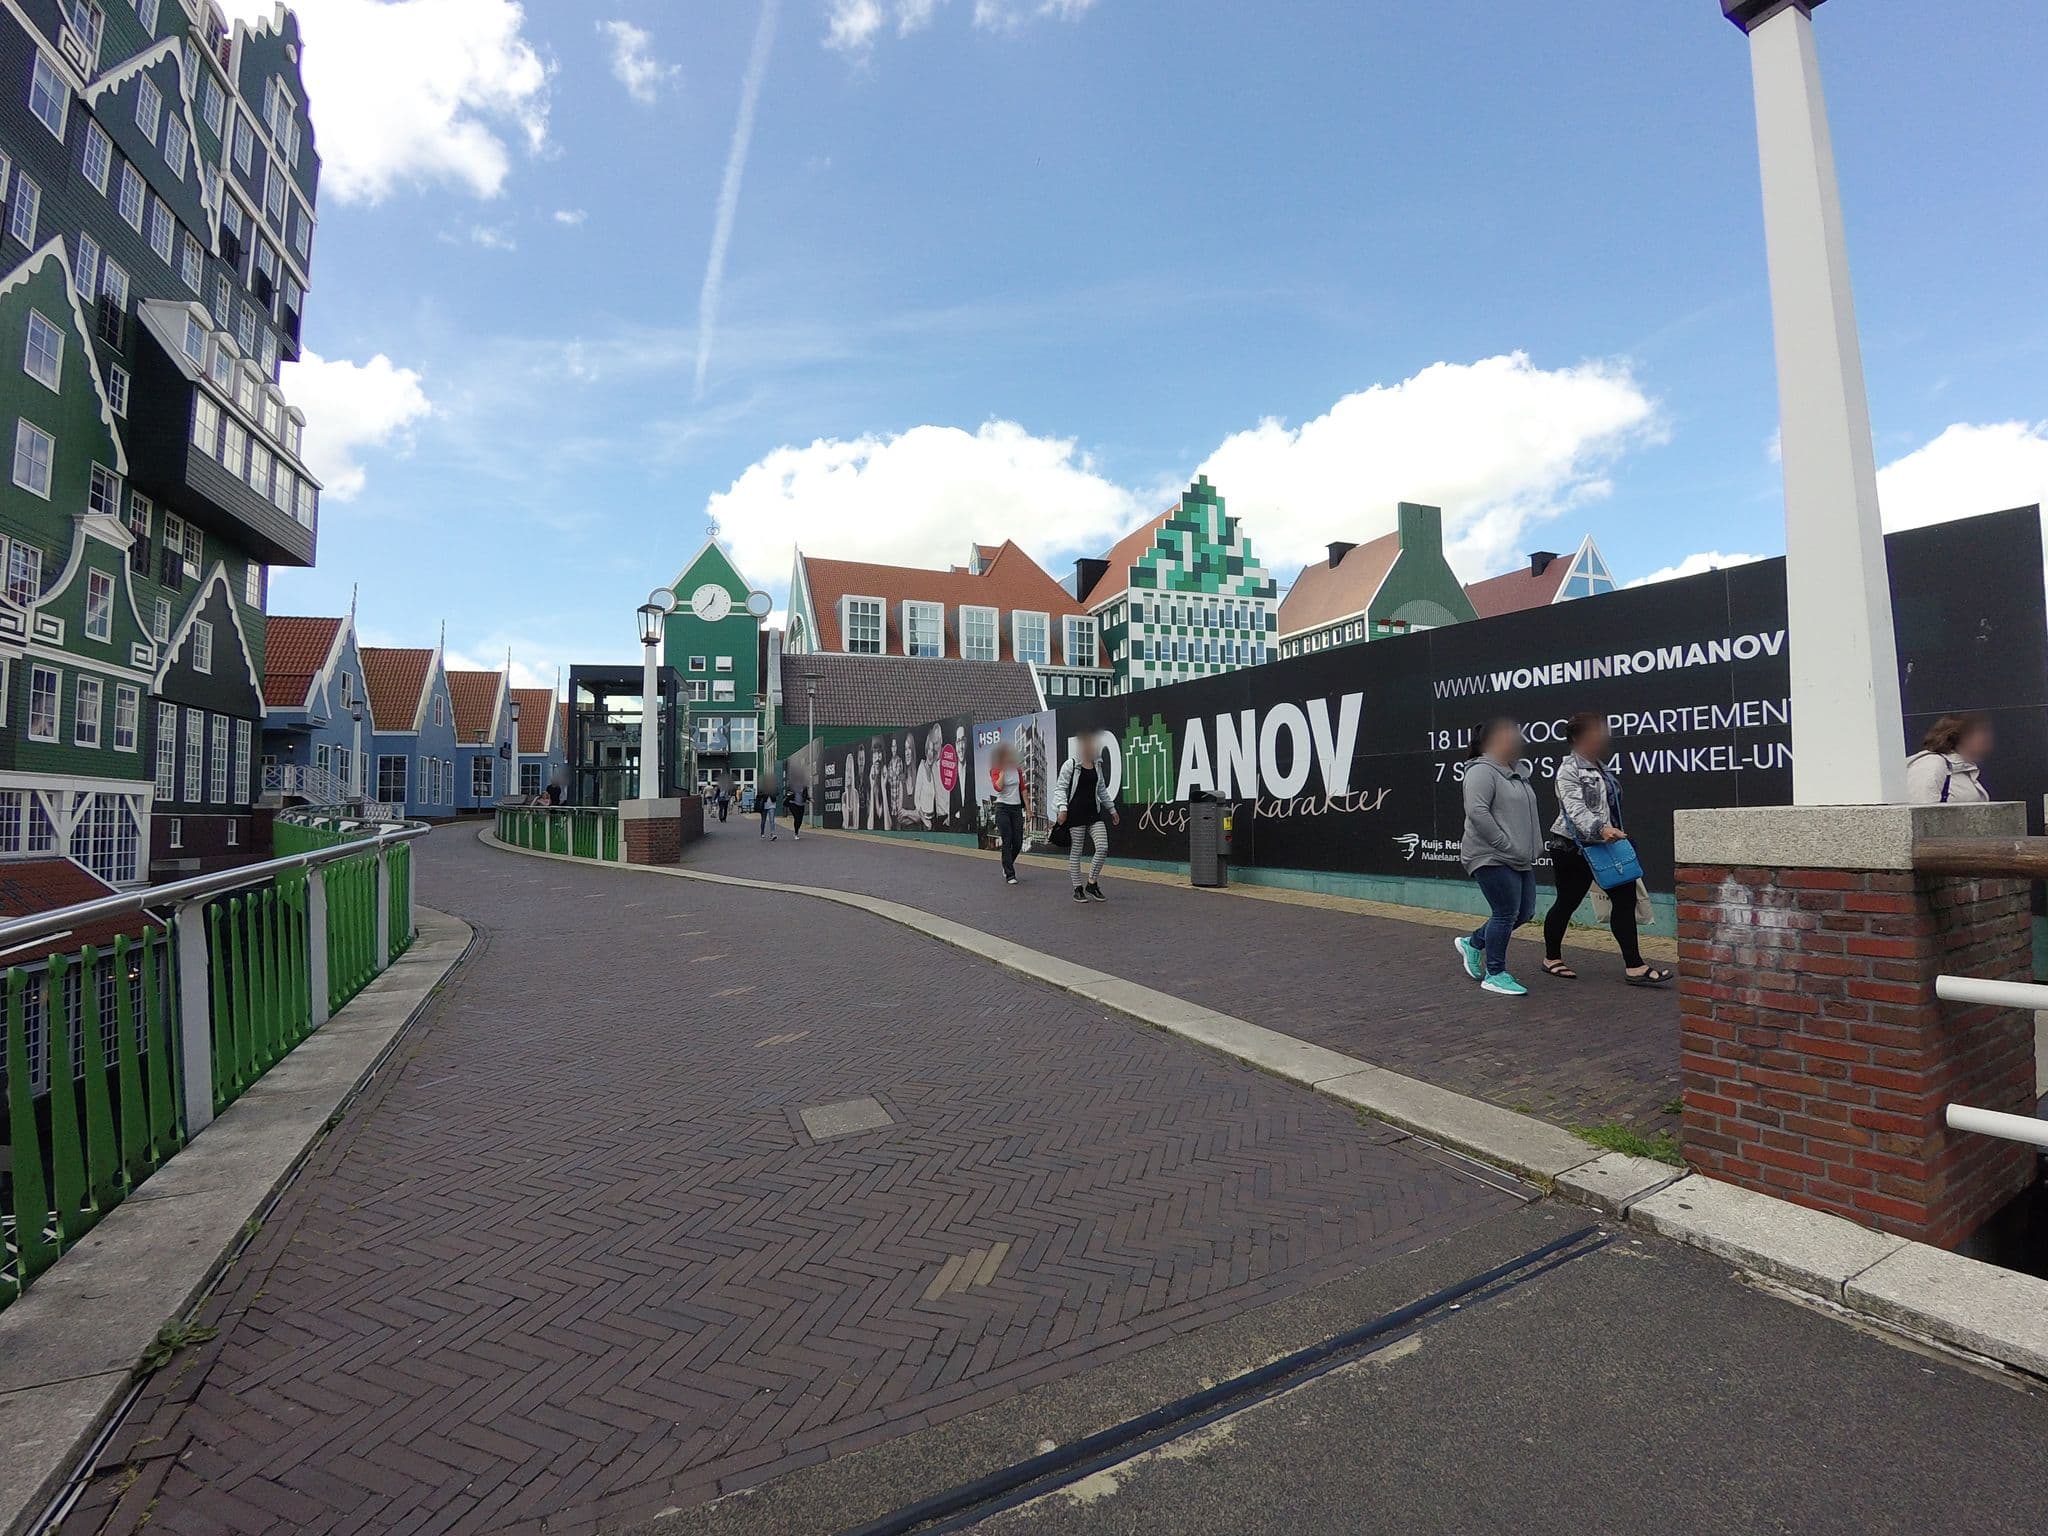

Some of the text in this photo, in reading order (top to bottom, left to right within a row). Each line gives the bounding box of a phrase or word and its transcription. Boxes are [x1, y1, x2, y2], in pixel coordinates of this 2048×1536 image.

[979, 730, 1001, 746] HSB
[1427, 730, 1451, 751] 18
[1434, 763, 1446, 783] 7
[1604, 752, 1623, 775] 4
[1253, 772, 1392, 819] karakter
[1421, 839, 1463, 852] Kuijs Rei
